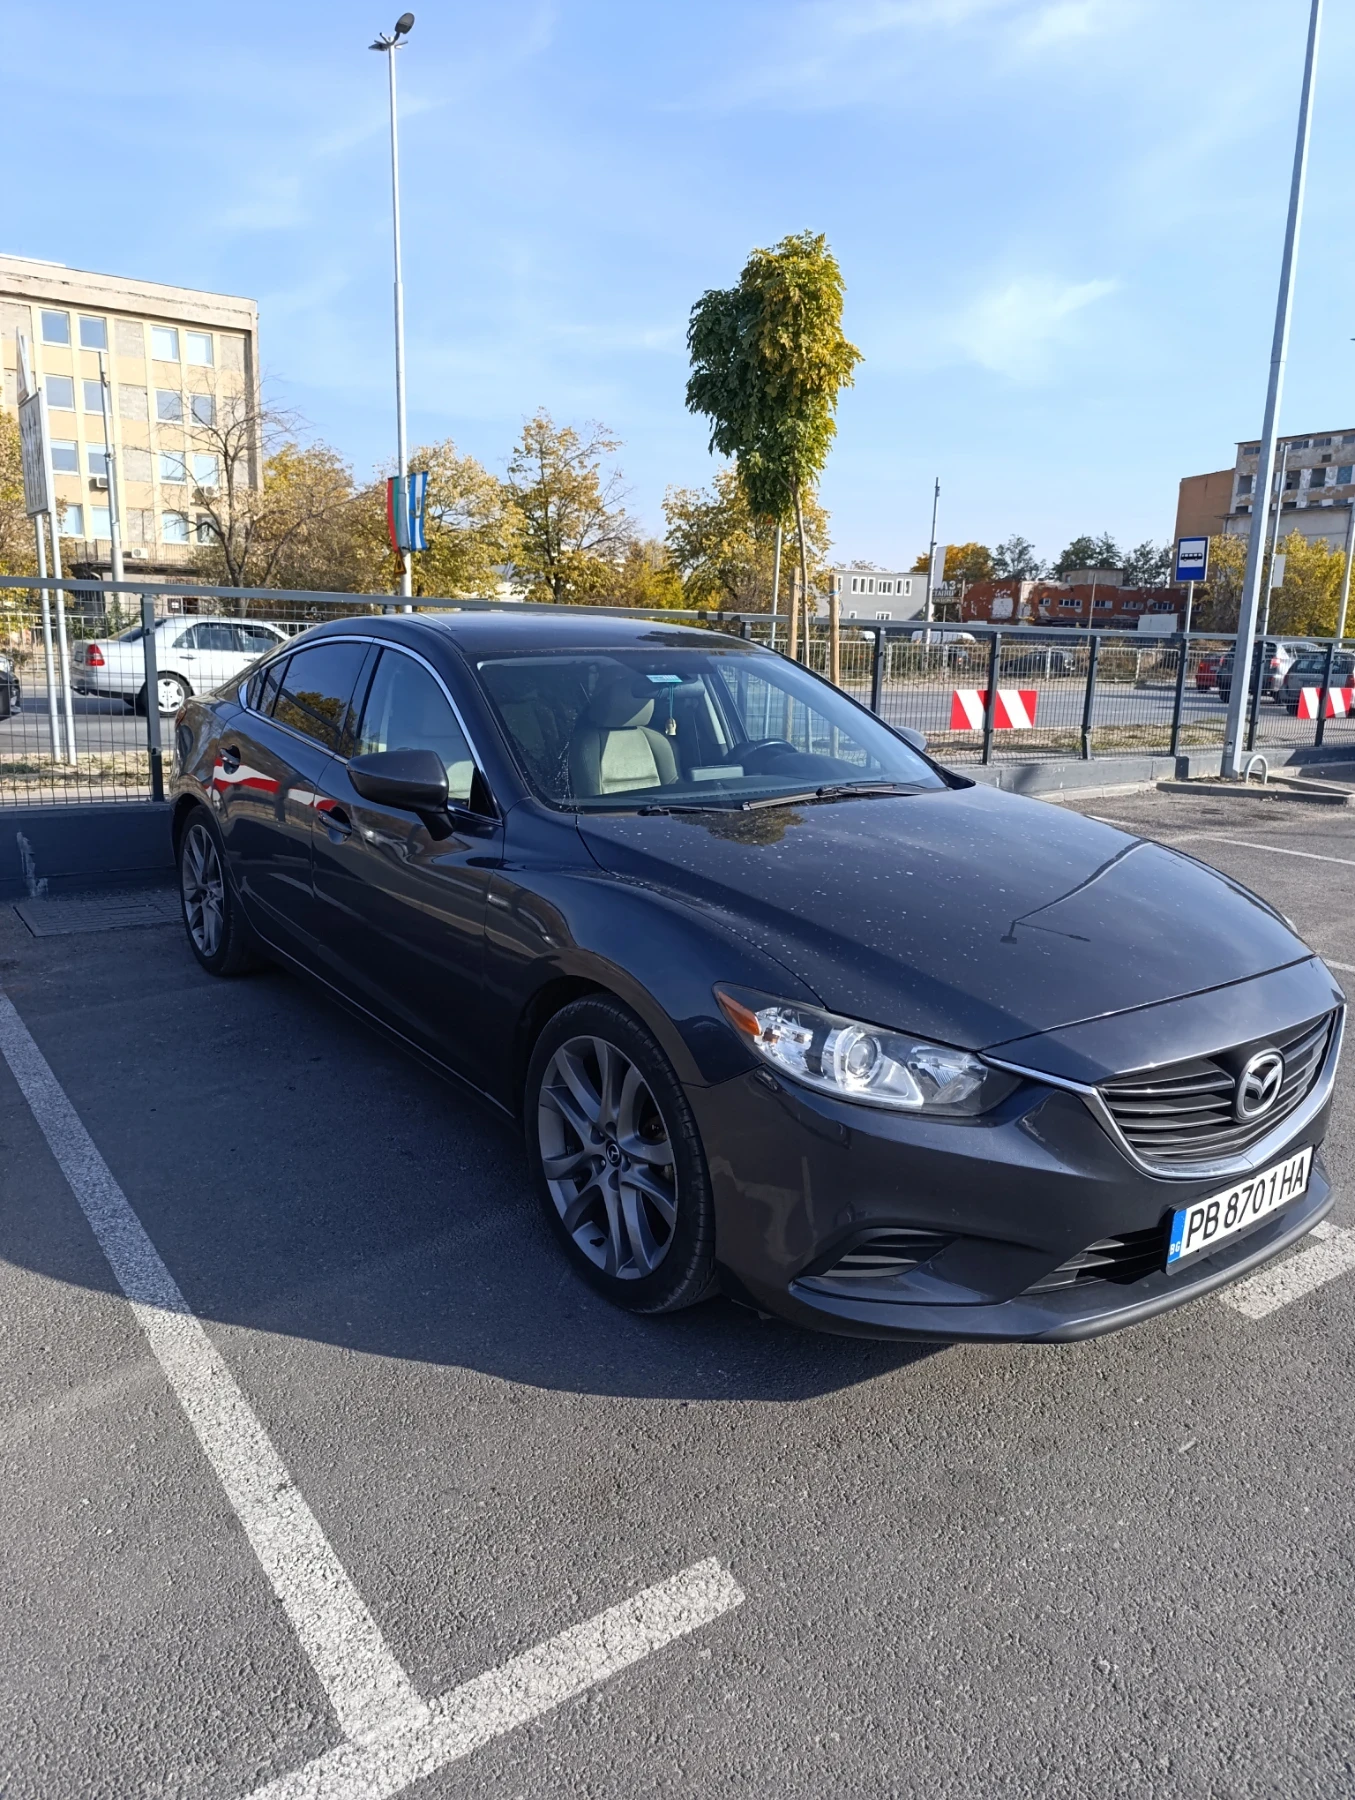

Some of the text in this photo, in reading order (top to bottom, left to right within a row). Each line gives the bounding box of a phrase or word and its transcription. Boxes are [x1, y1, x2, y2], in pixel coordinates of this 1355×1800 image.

[1186, 1156, 1305, 1248] PB 8701 HA
[1169, 1241, 1181, 1255] BG
